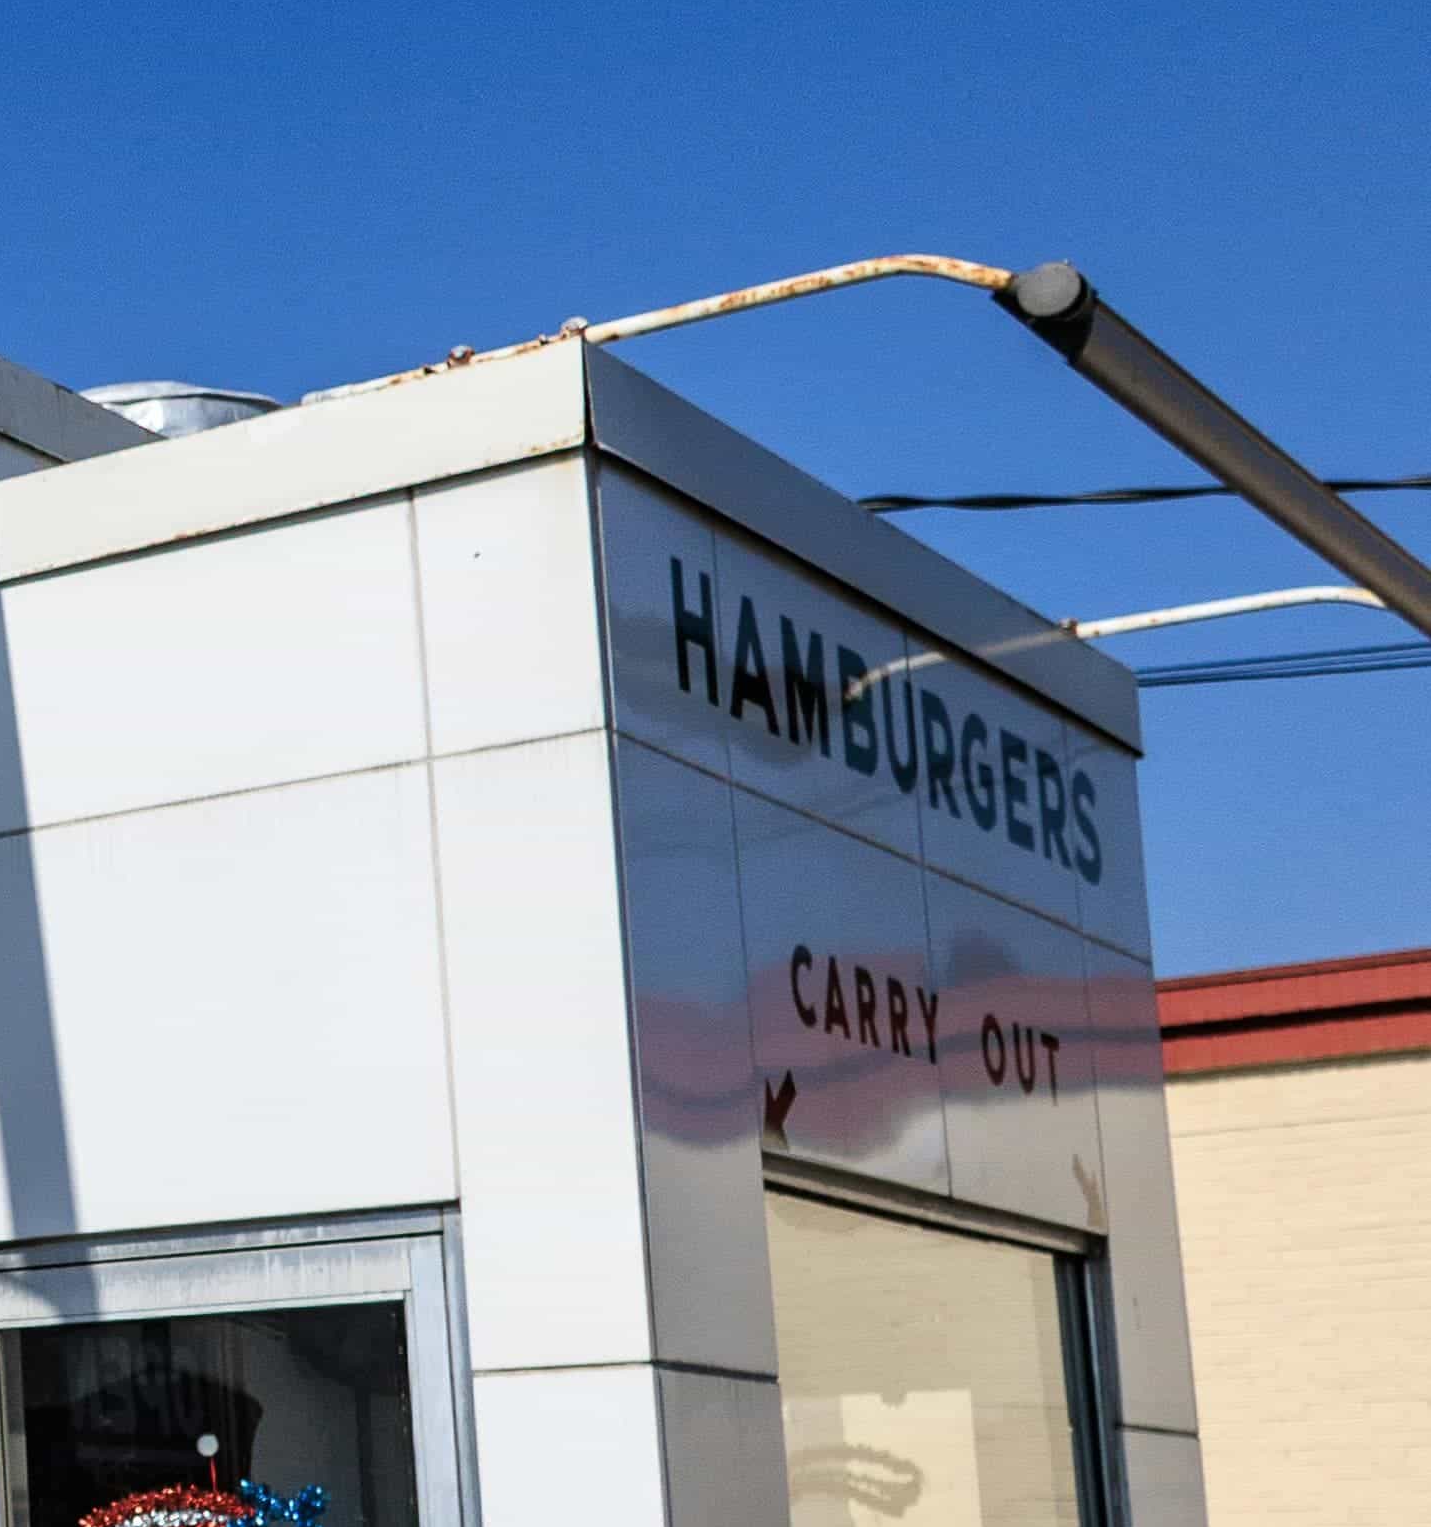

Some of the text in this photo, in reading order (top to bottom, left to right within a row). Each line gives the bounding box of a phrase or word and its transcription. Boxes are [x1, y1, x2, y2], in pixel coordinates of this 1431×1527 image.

[669, 556, 1104, 886] HAMBURGERS
[790, 945, 1061, 1106] CARRY OUT
